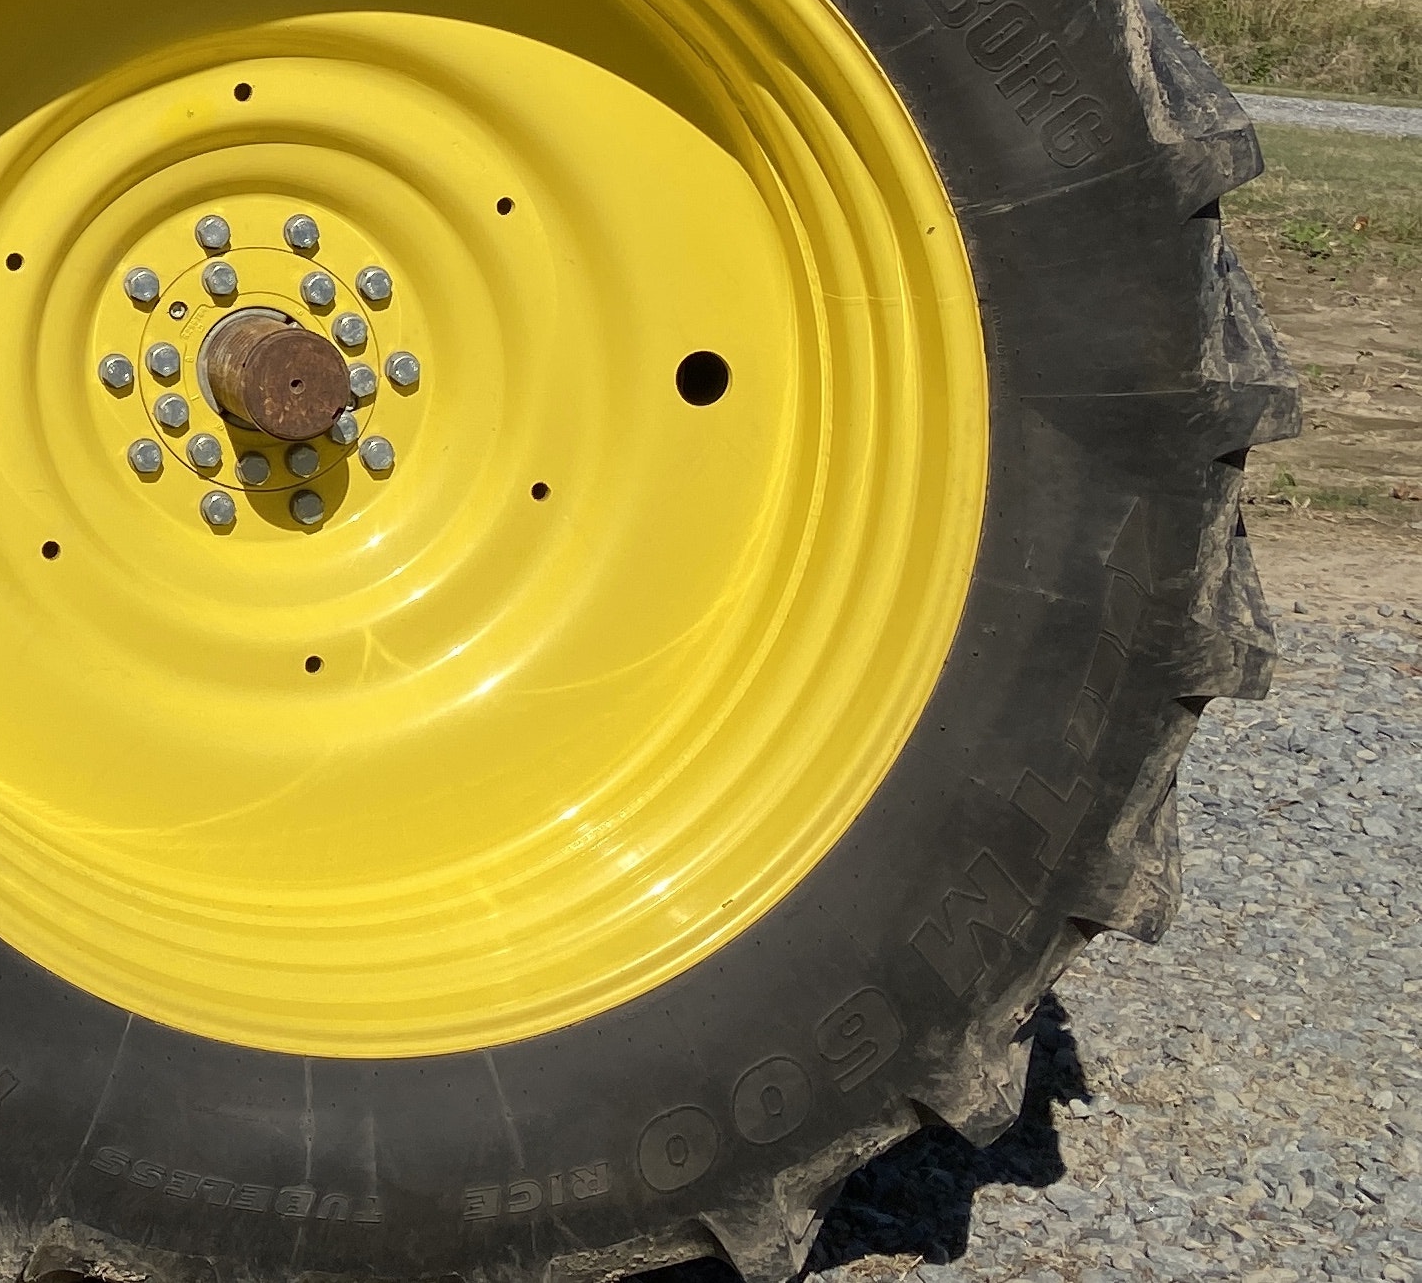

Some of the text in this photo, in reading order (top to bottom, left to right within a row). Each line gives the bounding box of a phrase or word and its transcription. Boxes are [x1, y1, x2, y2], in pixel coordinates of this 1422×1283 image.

[636, 986, 904, 1194] 600
[90, 1146, 382, 1225] TUBELESS
[463, 1160, 611, 1222] RICE
